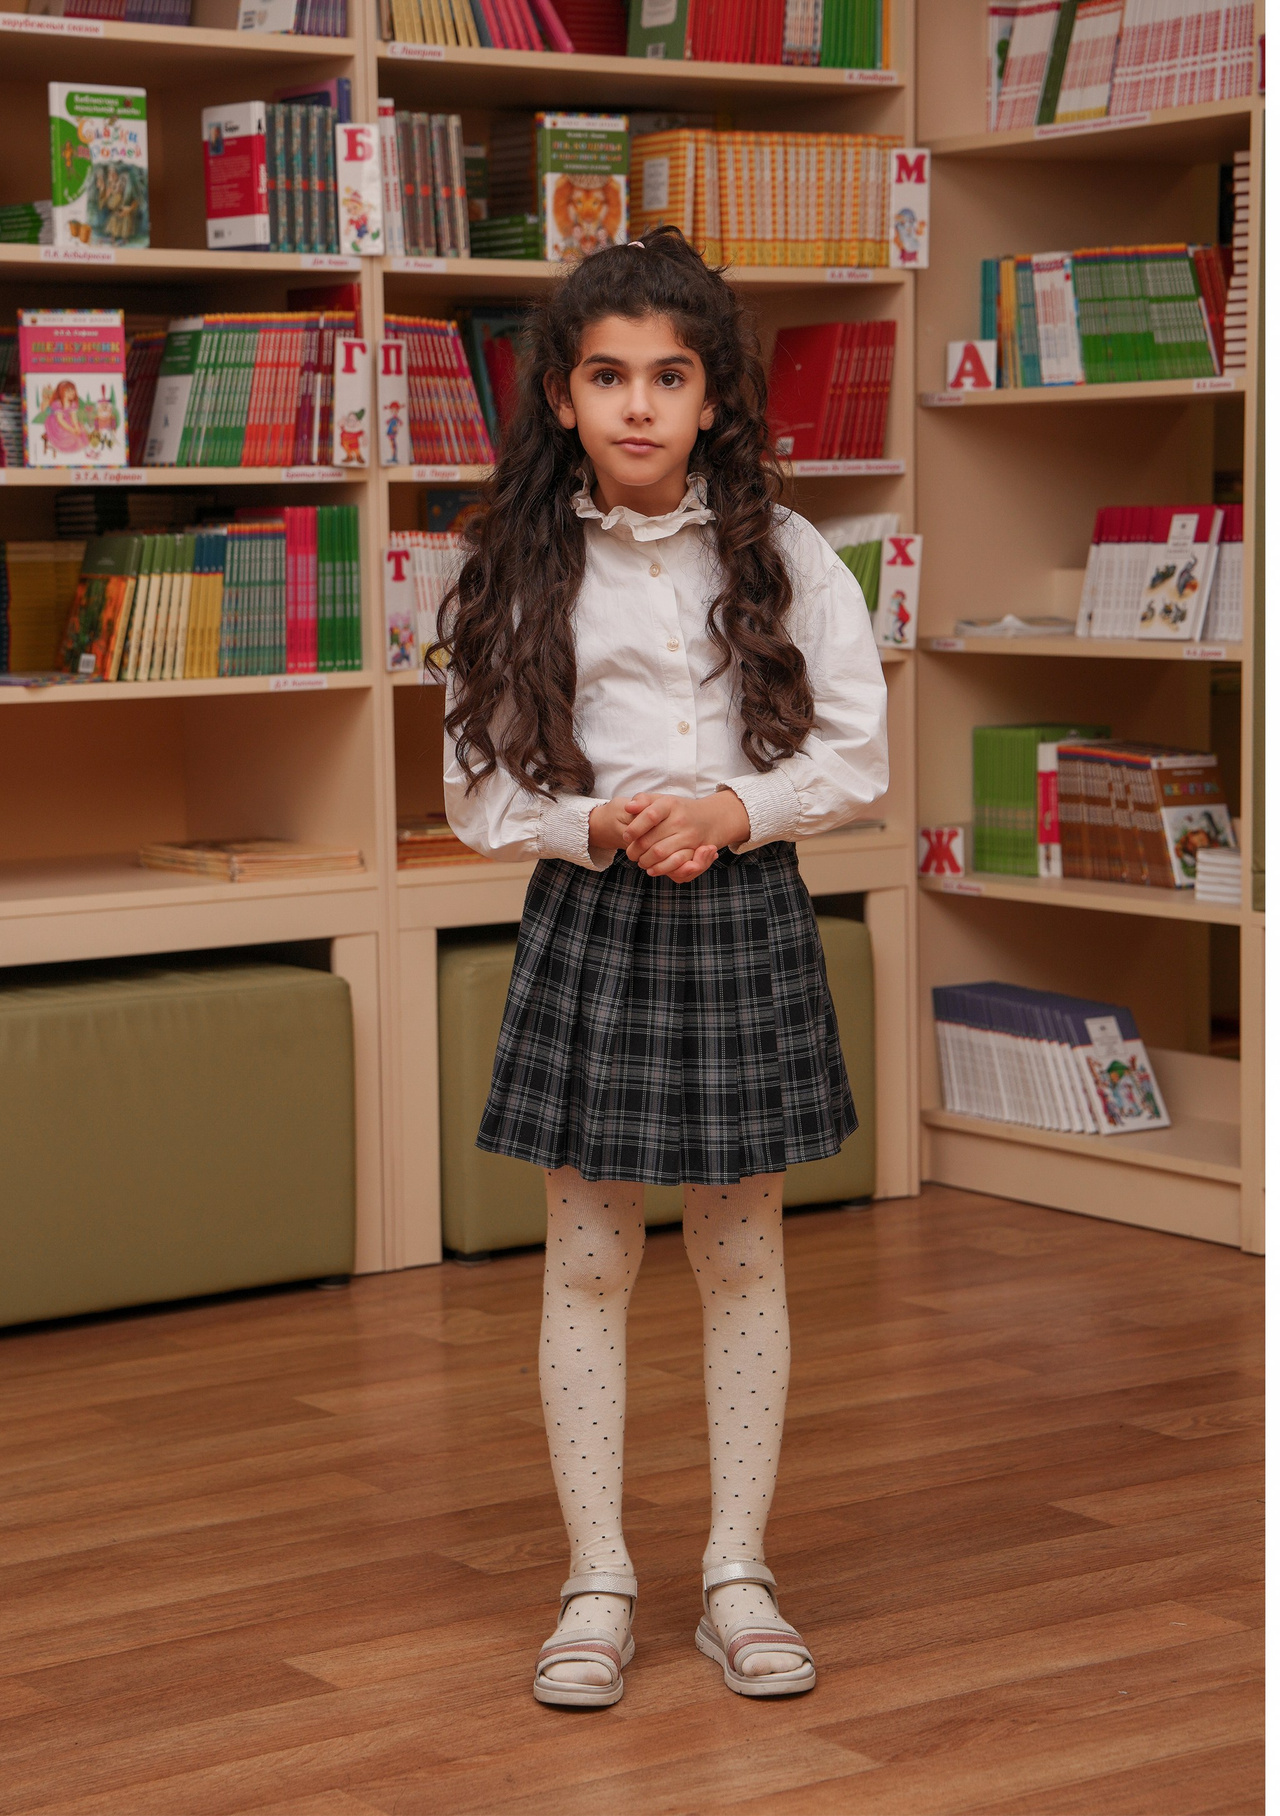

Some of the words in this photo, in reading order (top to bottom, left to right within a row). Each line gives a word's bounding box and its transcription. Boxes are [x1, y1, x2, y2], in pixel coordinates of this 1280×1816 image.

[343, 128, 373, 162] Б
[895, 154, 927, 185] М
[341, 341, 366, 374] Г
[381, 343, 404, 376] П
[949, 342, 993, 389] А
[387, 549, 411, 583] Т
[886, 537, 915, 566] Х
[920, 828, 963, 875] Ж
